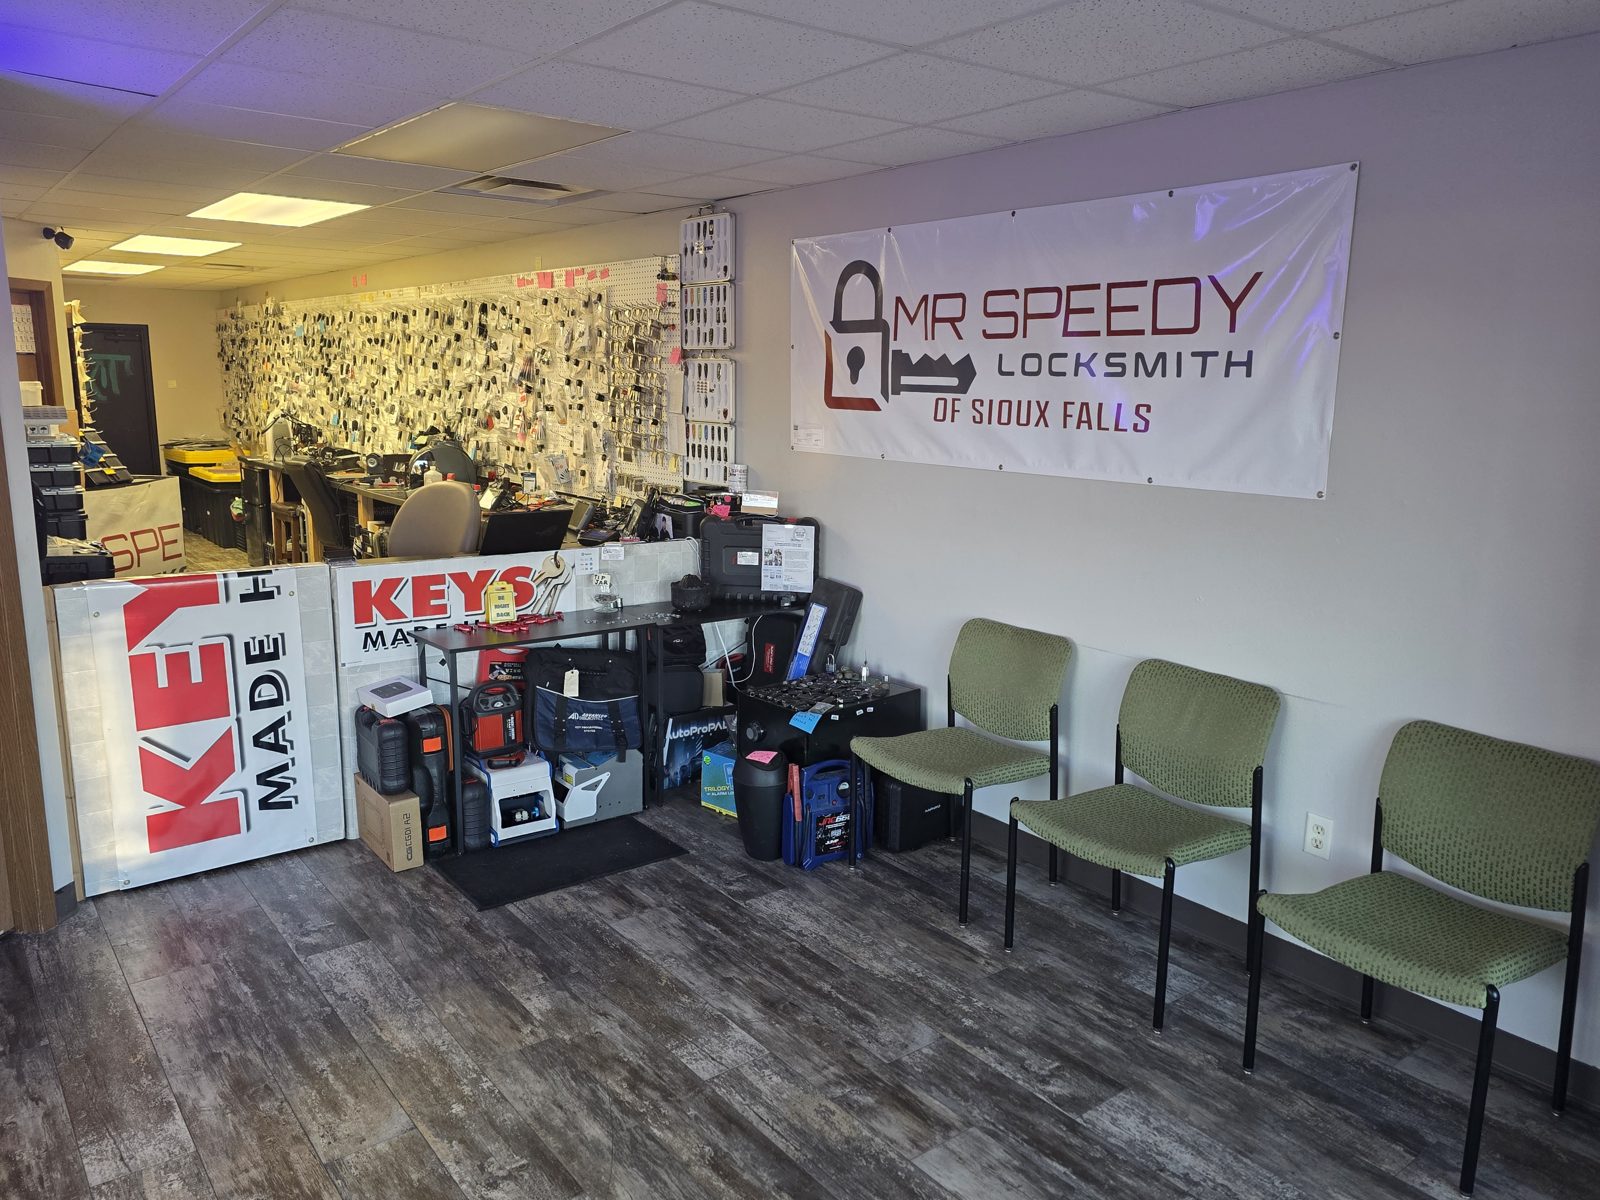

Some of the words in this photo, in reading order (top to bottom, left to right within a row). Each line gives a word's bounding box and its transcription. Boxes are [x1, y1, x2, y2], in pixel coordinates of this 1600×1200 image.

[892, 292, 967, 341] MR
[982, 271, 1264, 341] SPEEDY
[997, 349, 1255, 379] LOCKSMITH
[933, 397, 962, 424] OF
[972, 398, 1050, 429] SIOUX
[1062, 401, 1153, 433] FALLS
[352, 565, 539, 628] KEYS
[243, 633, 297, 811] MADE
